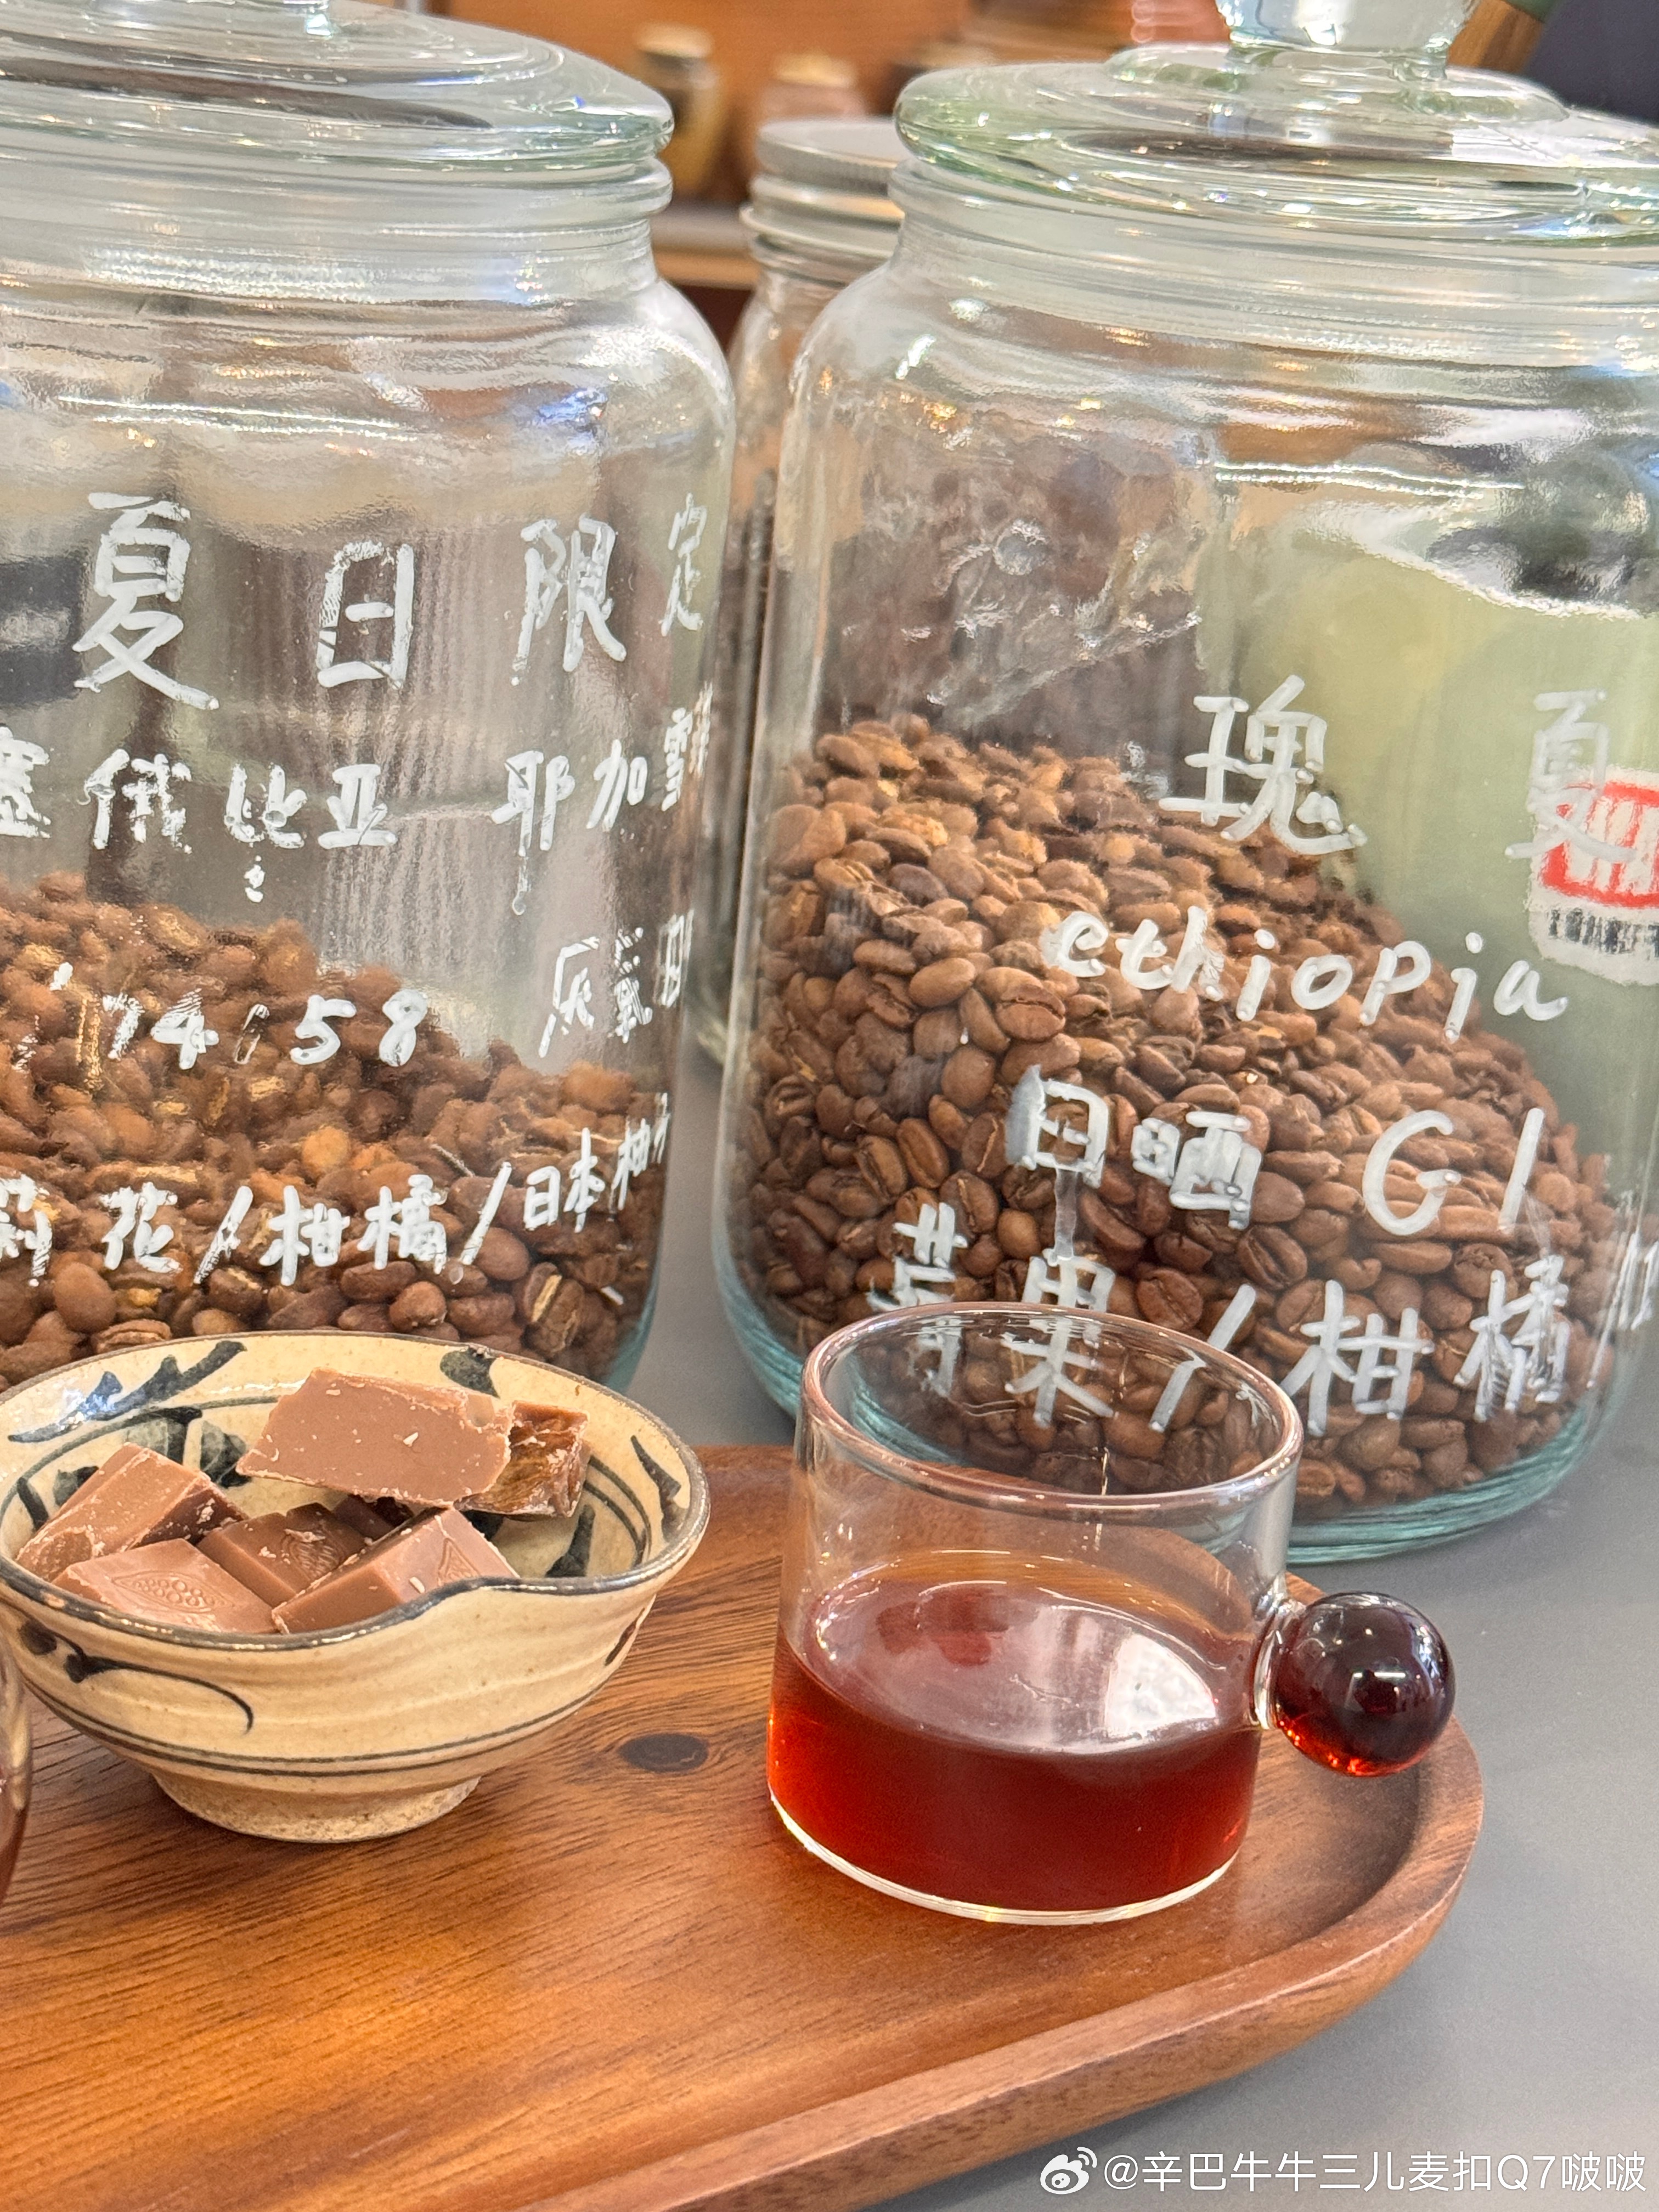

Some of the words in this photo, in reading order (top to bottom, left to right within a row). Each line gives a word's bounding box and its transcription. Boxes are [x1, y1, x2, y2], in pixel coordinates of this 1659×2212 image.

[72, 492, 708, 710] 夏日限定
[1159, 674, 1639, 864] 瑰夏
[1039, 905, 1569, 1043] ethiopia
[1362, 1108, 1546, 1237] G1
